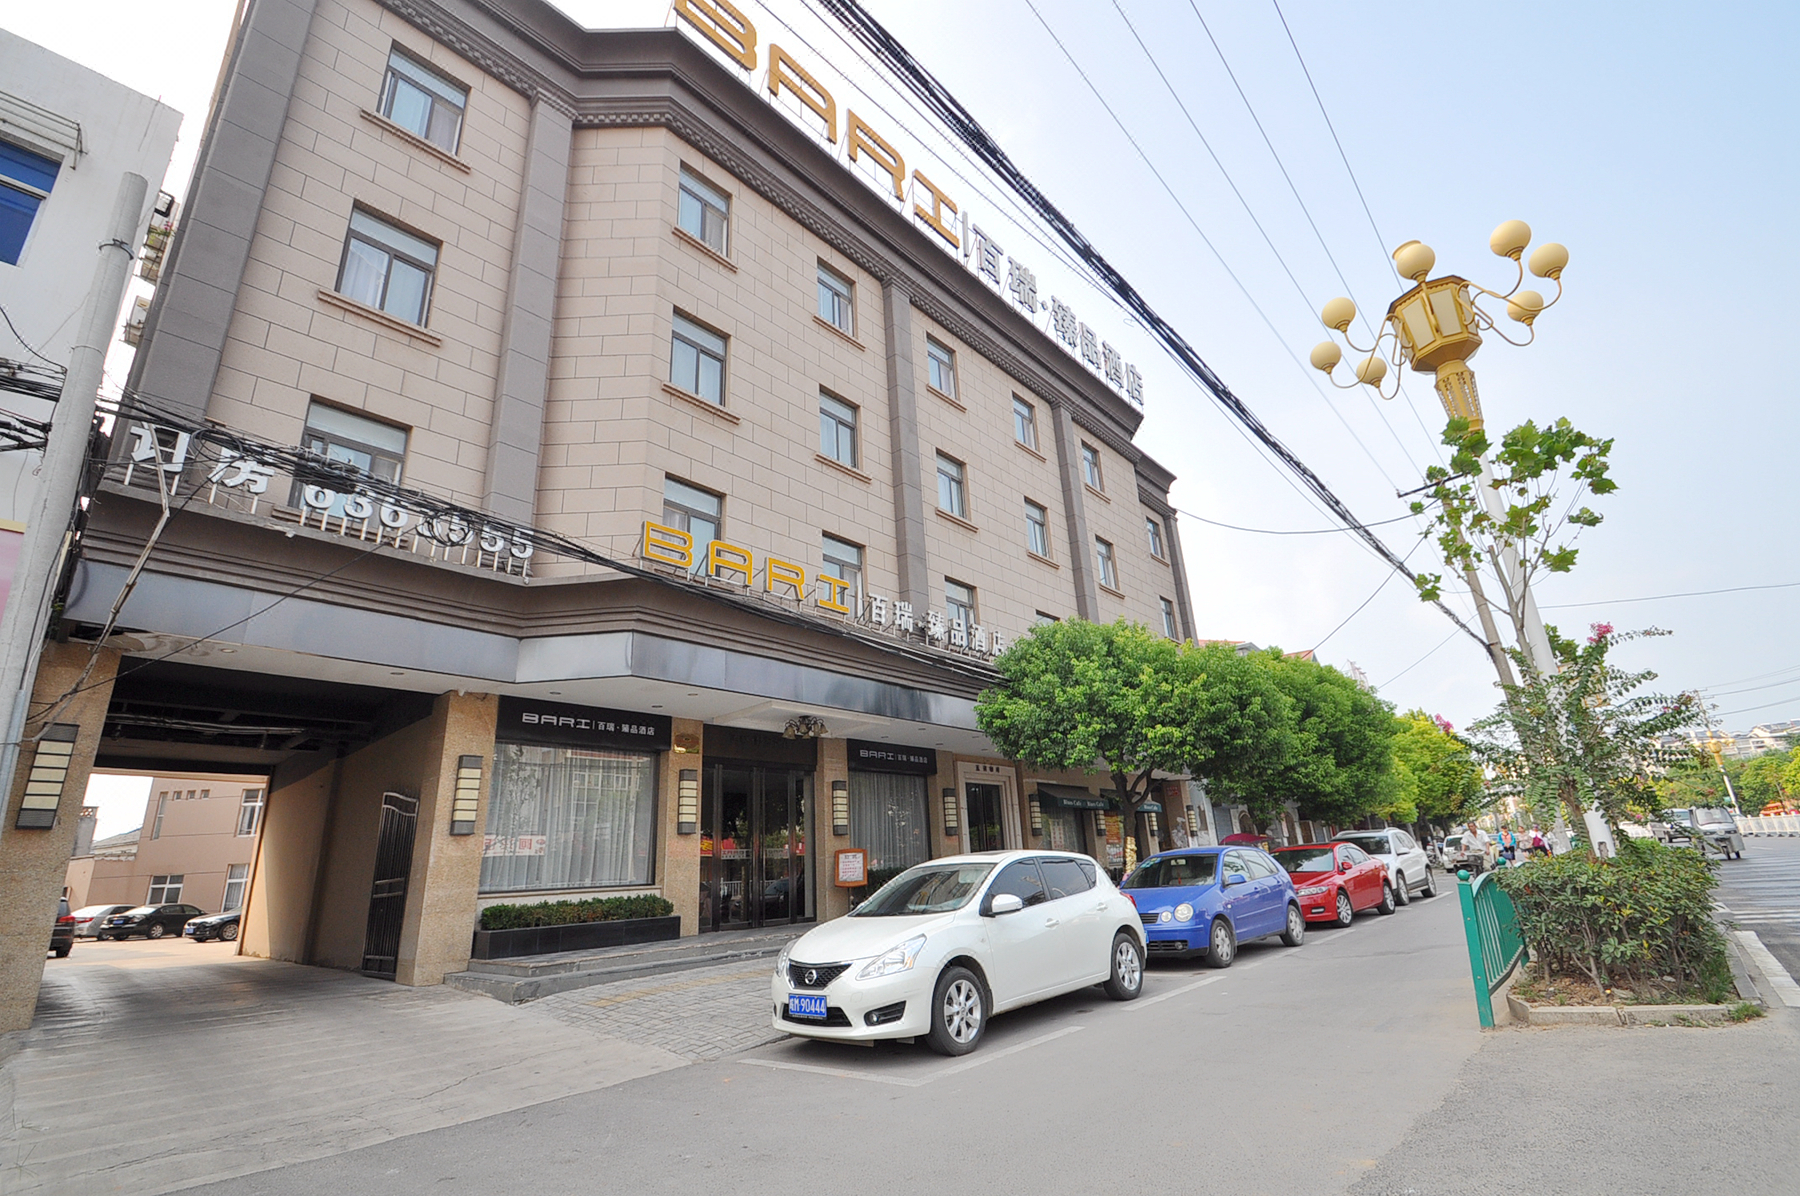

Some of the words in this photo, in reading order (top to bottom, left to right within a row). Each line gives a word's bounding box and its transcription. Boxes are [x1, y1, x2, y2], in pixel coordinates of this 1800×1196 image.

[674, 0, 960, 249] BARI
[642, 520, 850, 614] BARI
[521, 712, 591, 730] BARI
[860, 749, 895, 761] BARI
